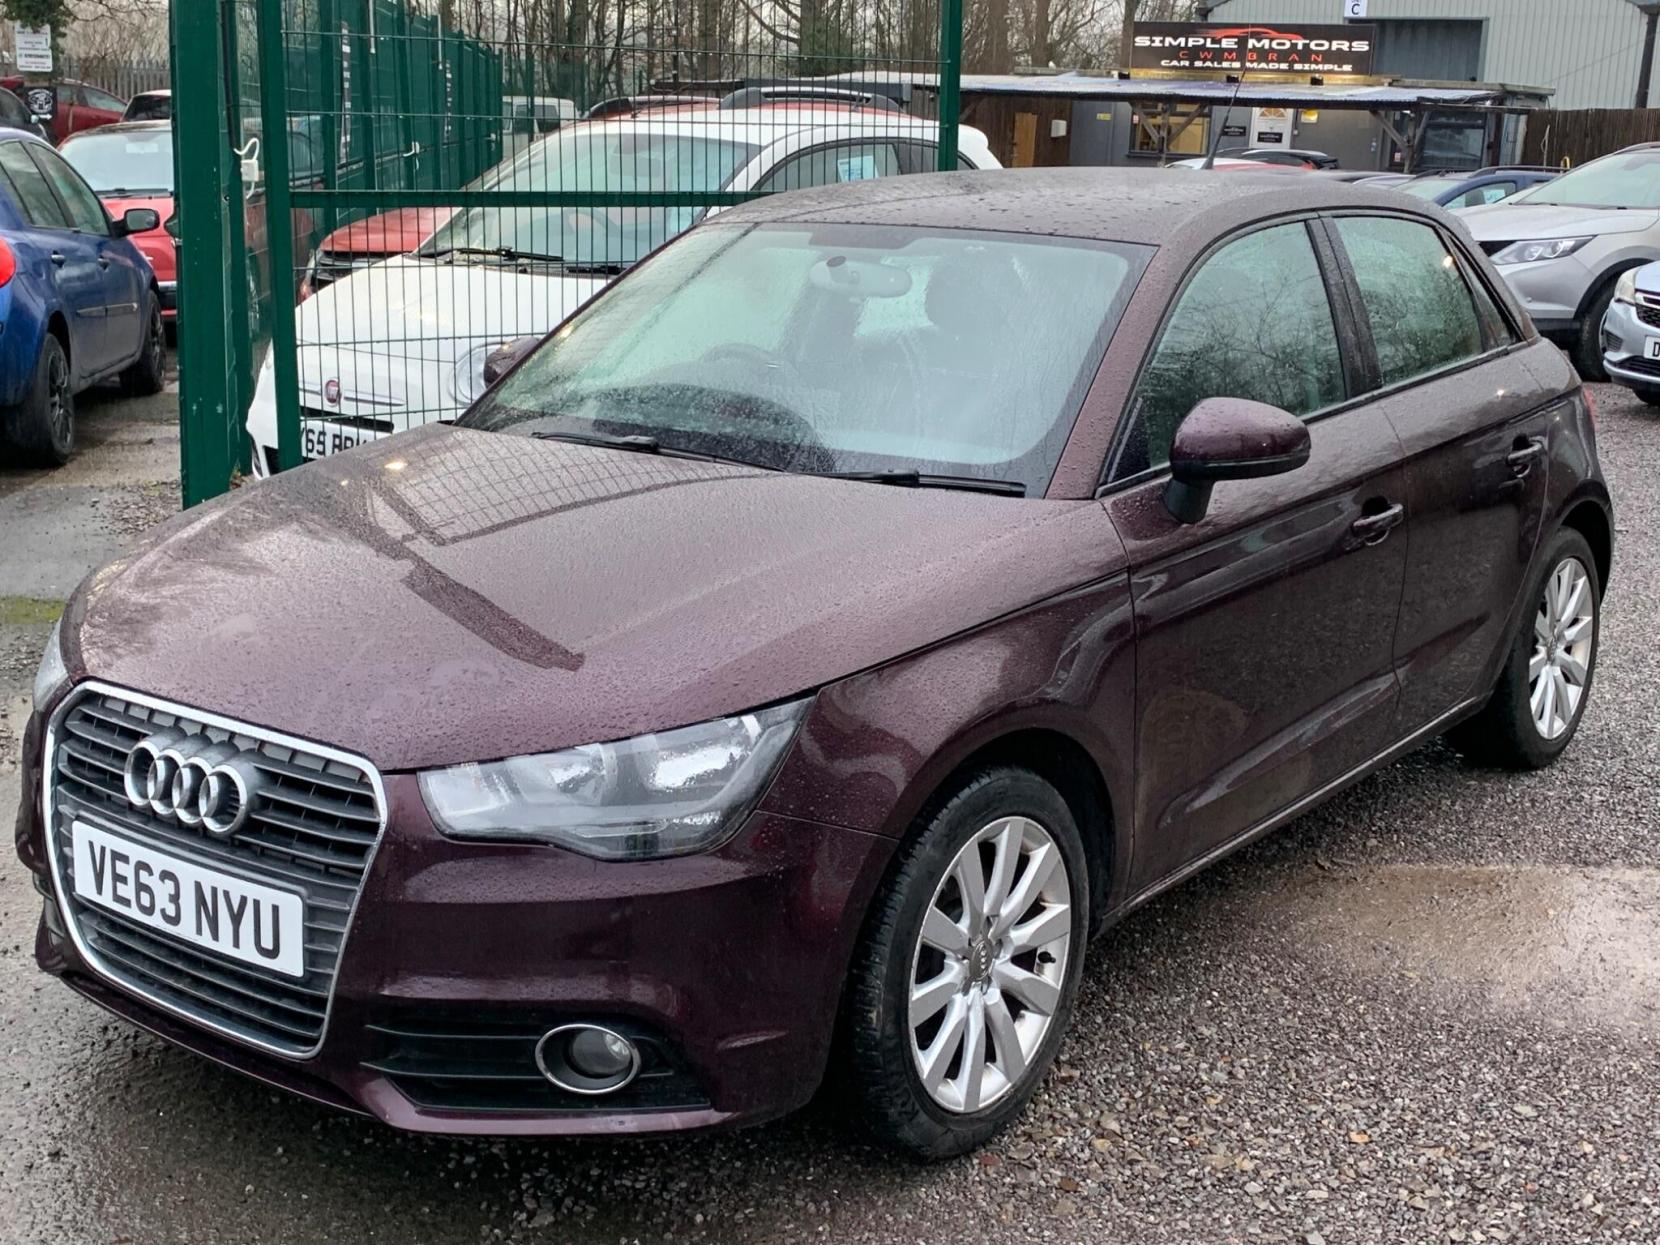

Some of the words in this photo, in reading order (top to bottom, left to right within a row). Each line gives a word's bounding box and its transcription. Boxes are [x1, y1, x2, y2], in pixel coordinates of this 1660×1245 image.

[1351, 3, 1360, 15] C
[1134, 36, 1238, 49] SIMPLE
[1247, 38, 1370, 51] MOTORS
[1179, 51, 1322, 62] CWMBRAN
[1293, 63, 1353, 71] SIMPLE
[301, 427, 326, 456] 65
[88, 840, 182, 927] VE63
[194, 880, 281, 960] NYU
